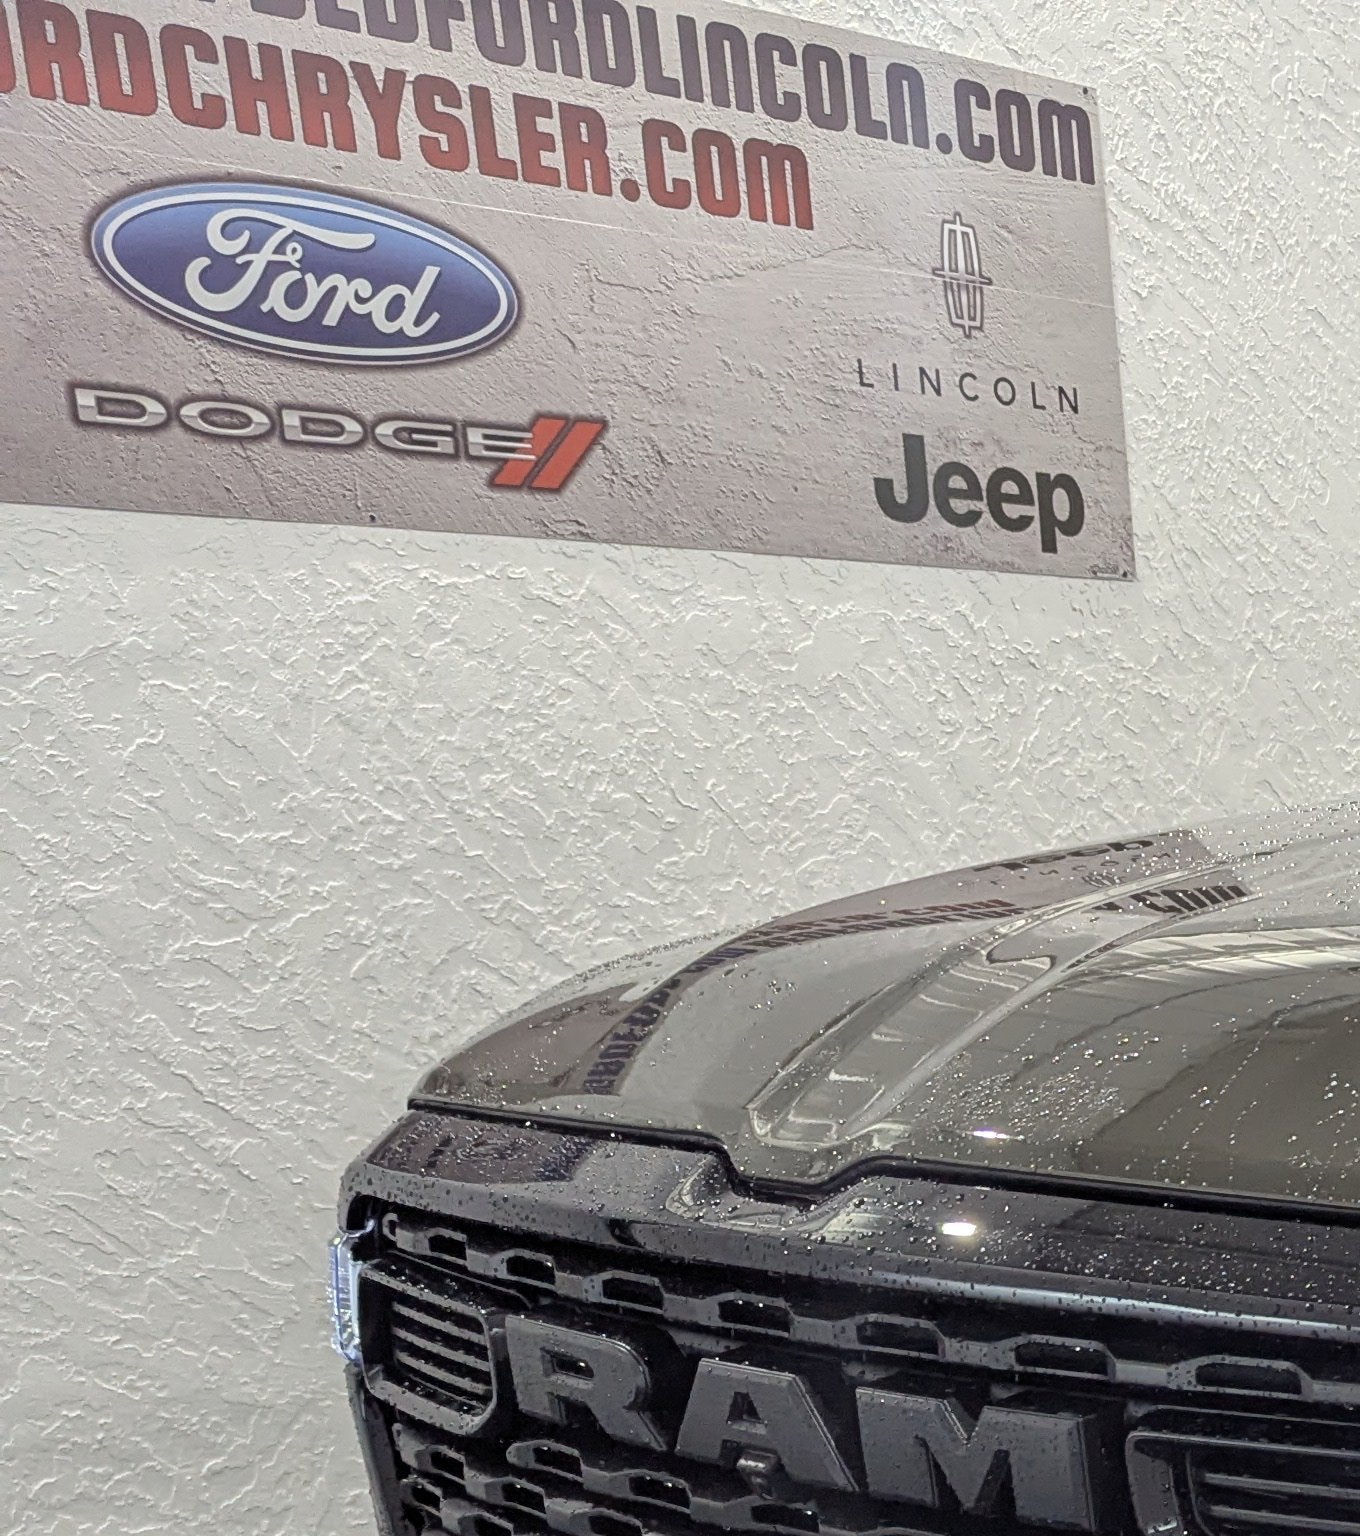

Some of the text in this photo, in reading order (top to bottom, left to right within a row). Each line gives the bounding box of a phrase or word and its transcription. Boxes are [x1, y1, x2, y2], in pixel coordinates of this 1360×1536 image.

[250, 0, 1096, 185] FORDLINCOLN.COM
[184, 208, 441, 338] Ford
[74, 387, 538, 461] DODGE
[857, 358, 1079, 414] LINCOLN
[873, 432, 1085, 554] Jeep
[504, 1314, 1098, 1532] RAM
